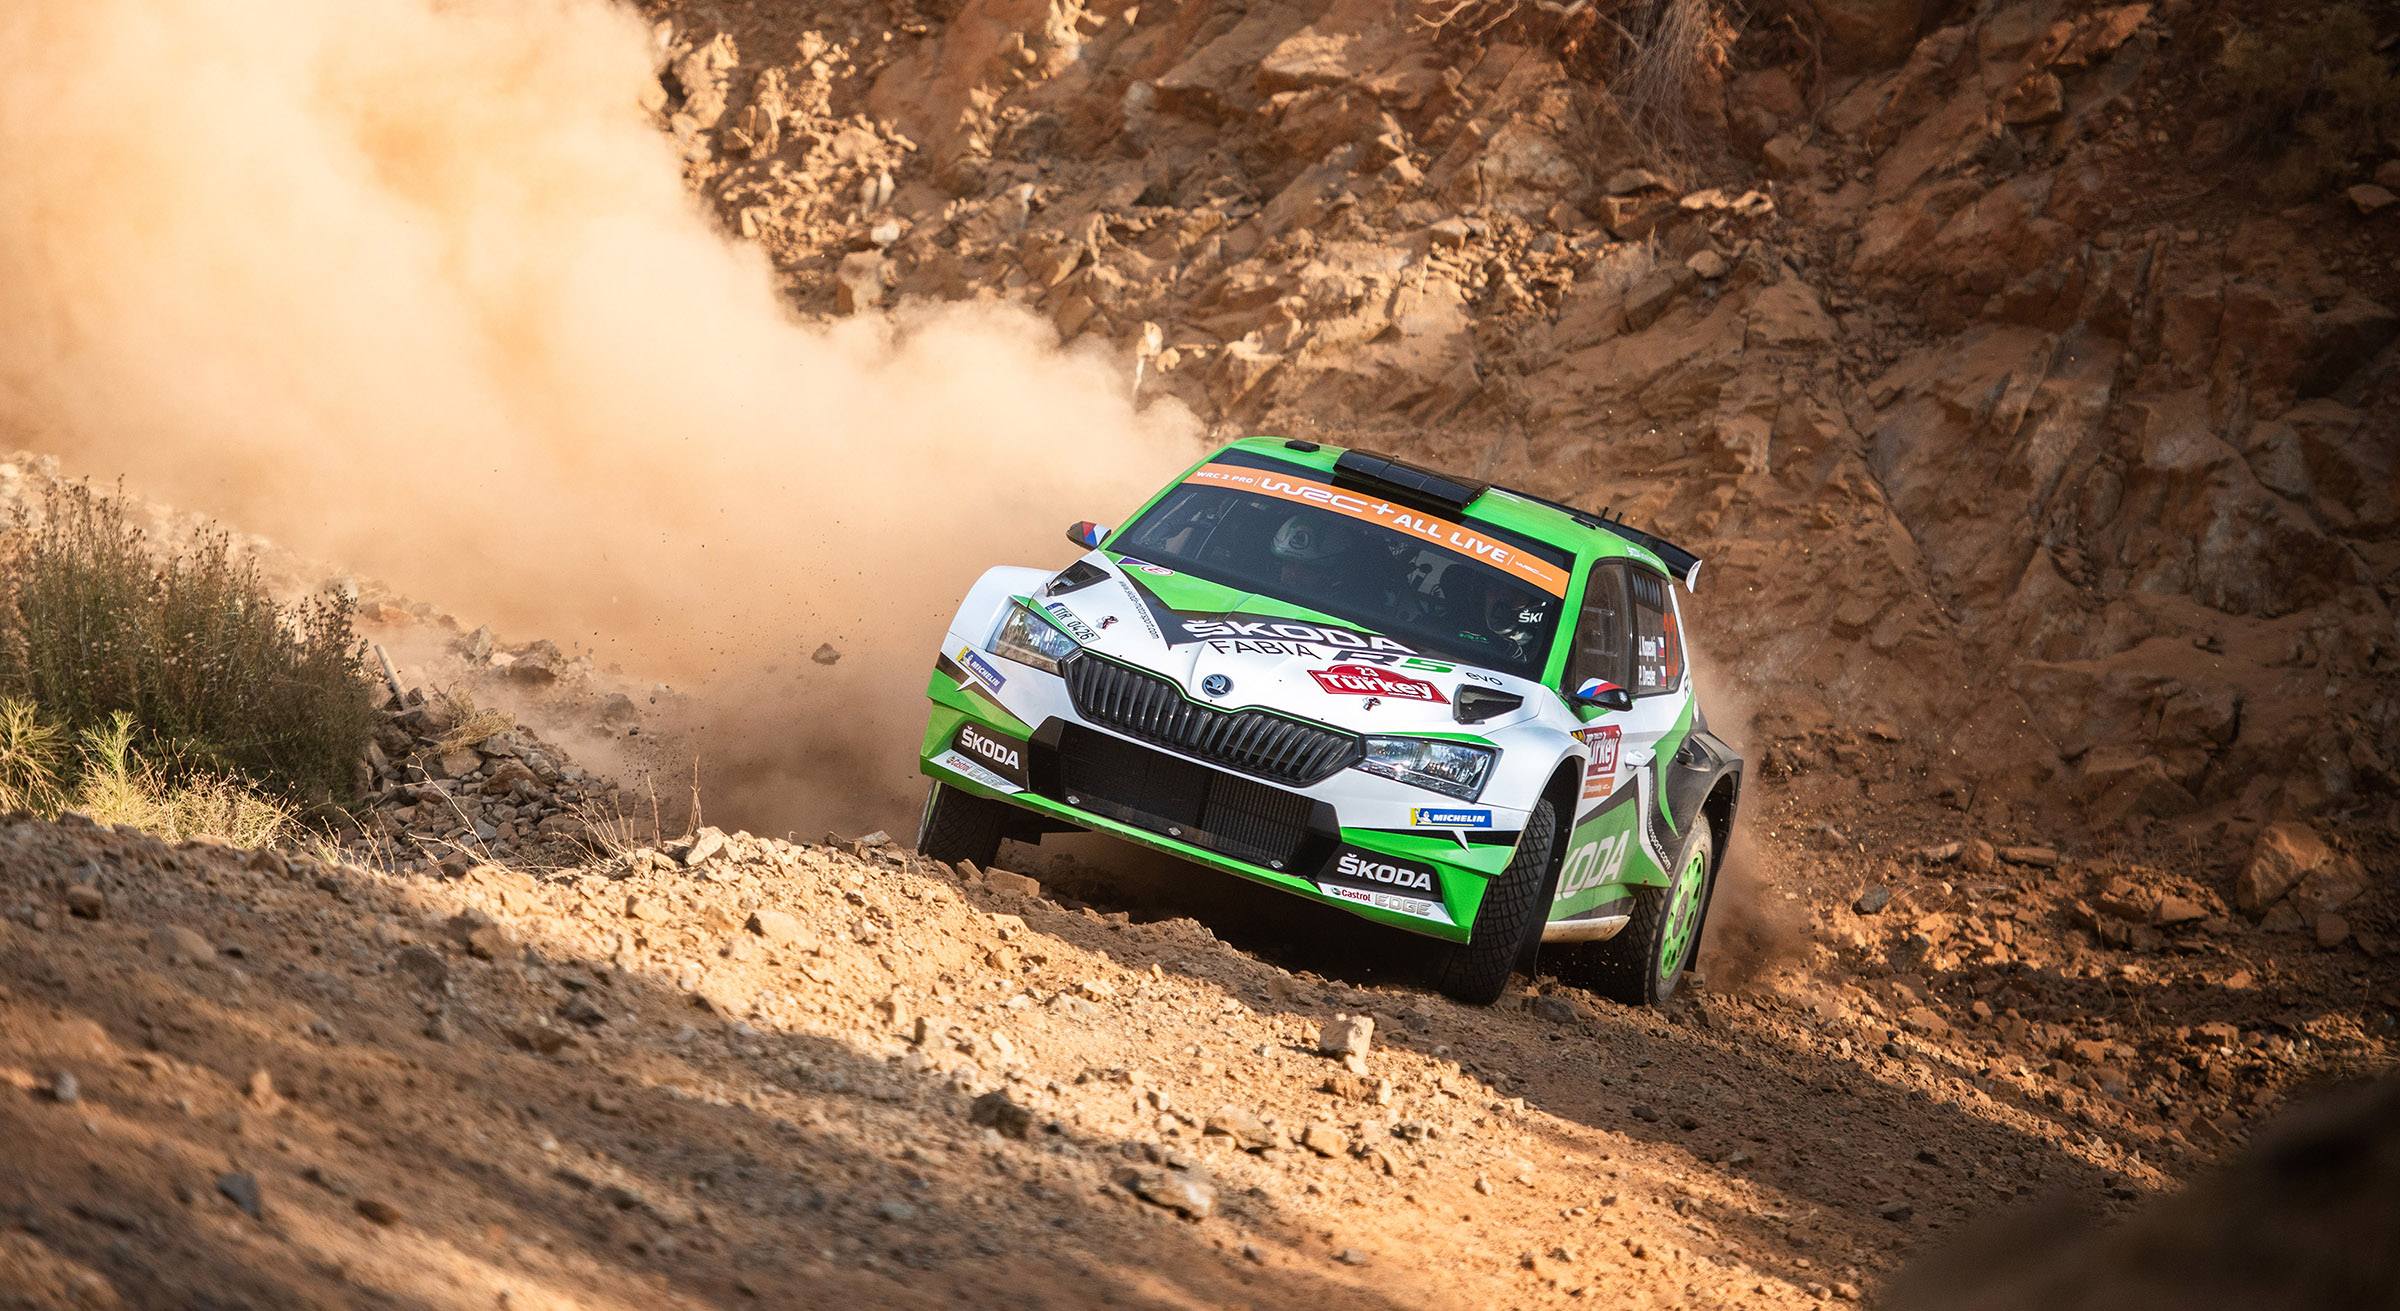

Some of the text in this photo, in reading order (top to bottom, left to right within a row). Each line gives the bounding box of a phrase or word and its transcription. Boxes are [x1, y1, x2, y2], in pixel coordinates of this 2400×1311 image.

[1196, 471, 1220, 479] WRC
[1231, 475, 1254, 484] PRO
[1392, 514, 1442, 539] ALL
[1449, 531, 1509, 564] LIVE
[1067, 620, 1095, 641] 0426
[1181, 619, 1419, 655] ŠKODA
[1208, 639, 1323, 661] FABIA
[1332, 649, 1457, 674] R5
[970, 660, 1001, 687] MICHELIN
[1354, 666, 1380, 678] 23
[1465, 671, 1503, 686] evo
[1317, 673, 1433, 700] Turkey
[961, 725, 1020, 771] ŠKODA
[1585, 731, 1619, 771] Turkey
[951, 757, 974, 772] Castrol
[1432, 814, 1485, 823] MICHELIN
[1337, 852, 1432, 892] ŠKODA
[1554, 829, 1631, 903] KODA
[1341, 889, 1433, 917] Castrol EDGE
